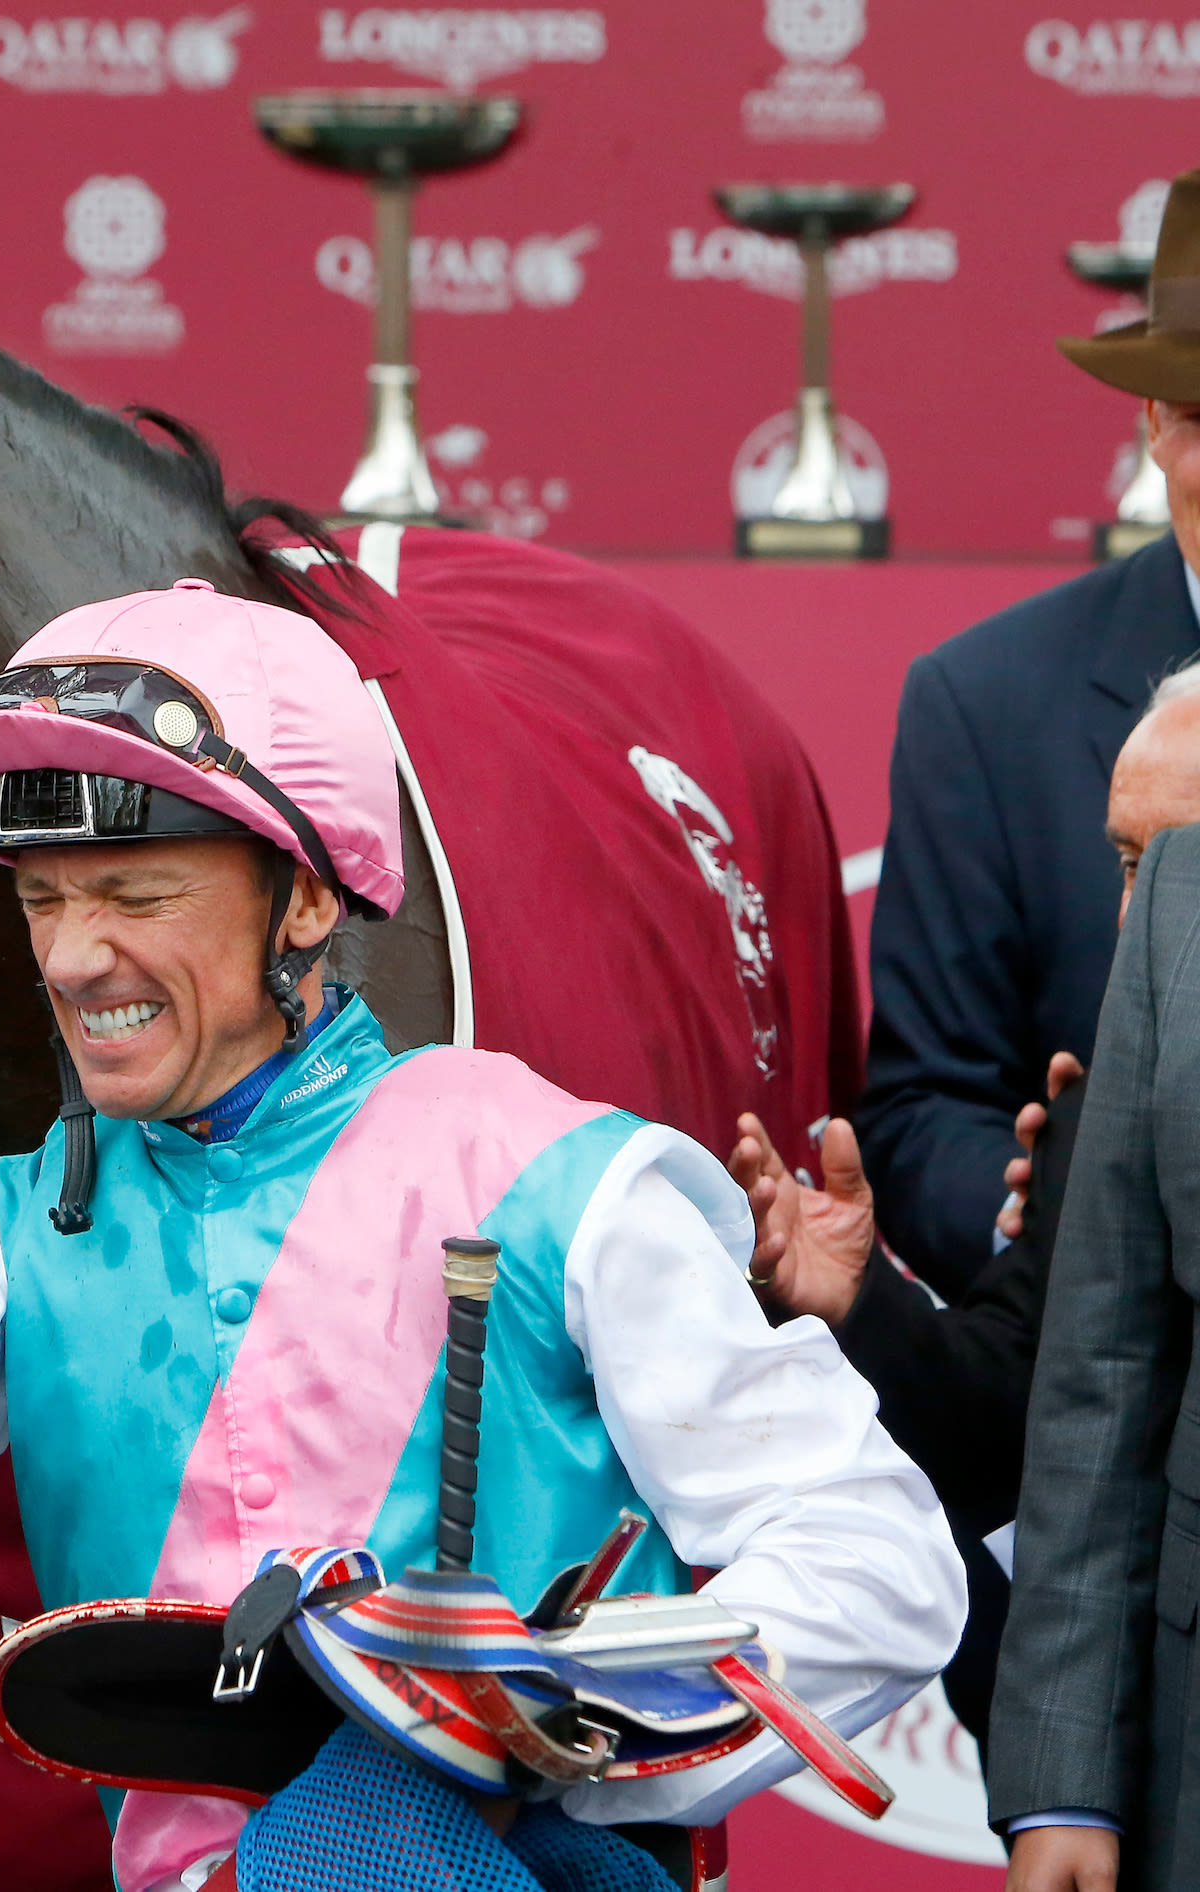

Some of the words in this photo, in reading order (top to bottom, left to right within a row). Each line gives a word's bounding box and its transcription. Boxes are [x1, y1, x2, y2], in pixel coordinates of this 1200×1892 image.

[320, 9, 606, 63] LONGINES
[315, 236, 512, 294] QTAR
[280, 1063, 348, 1109] JUDDMONTE
